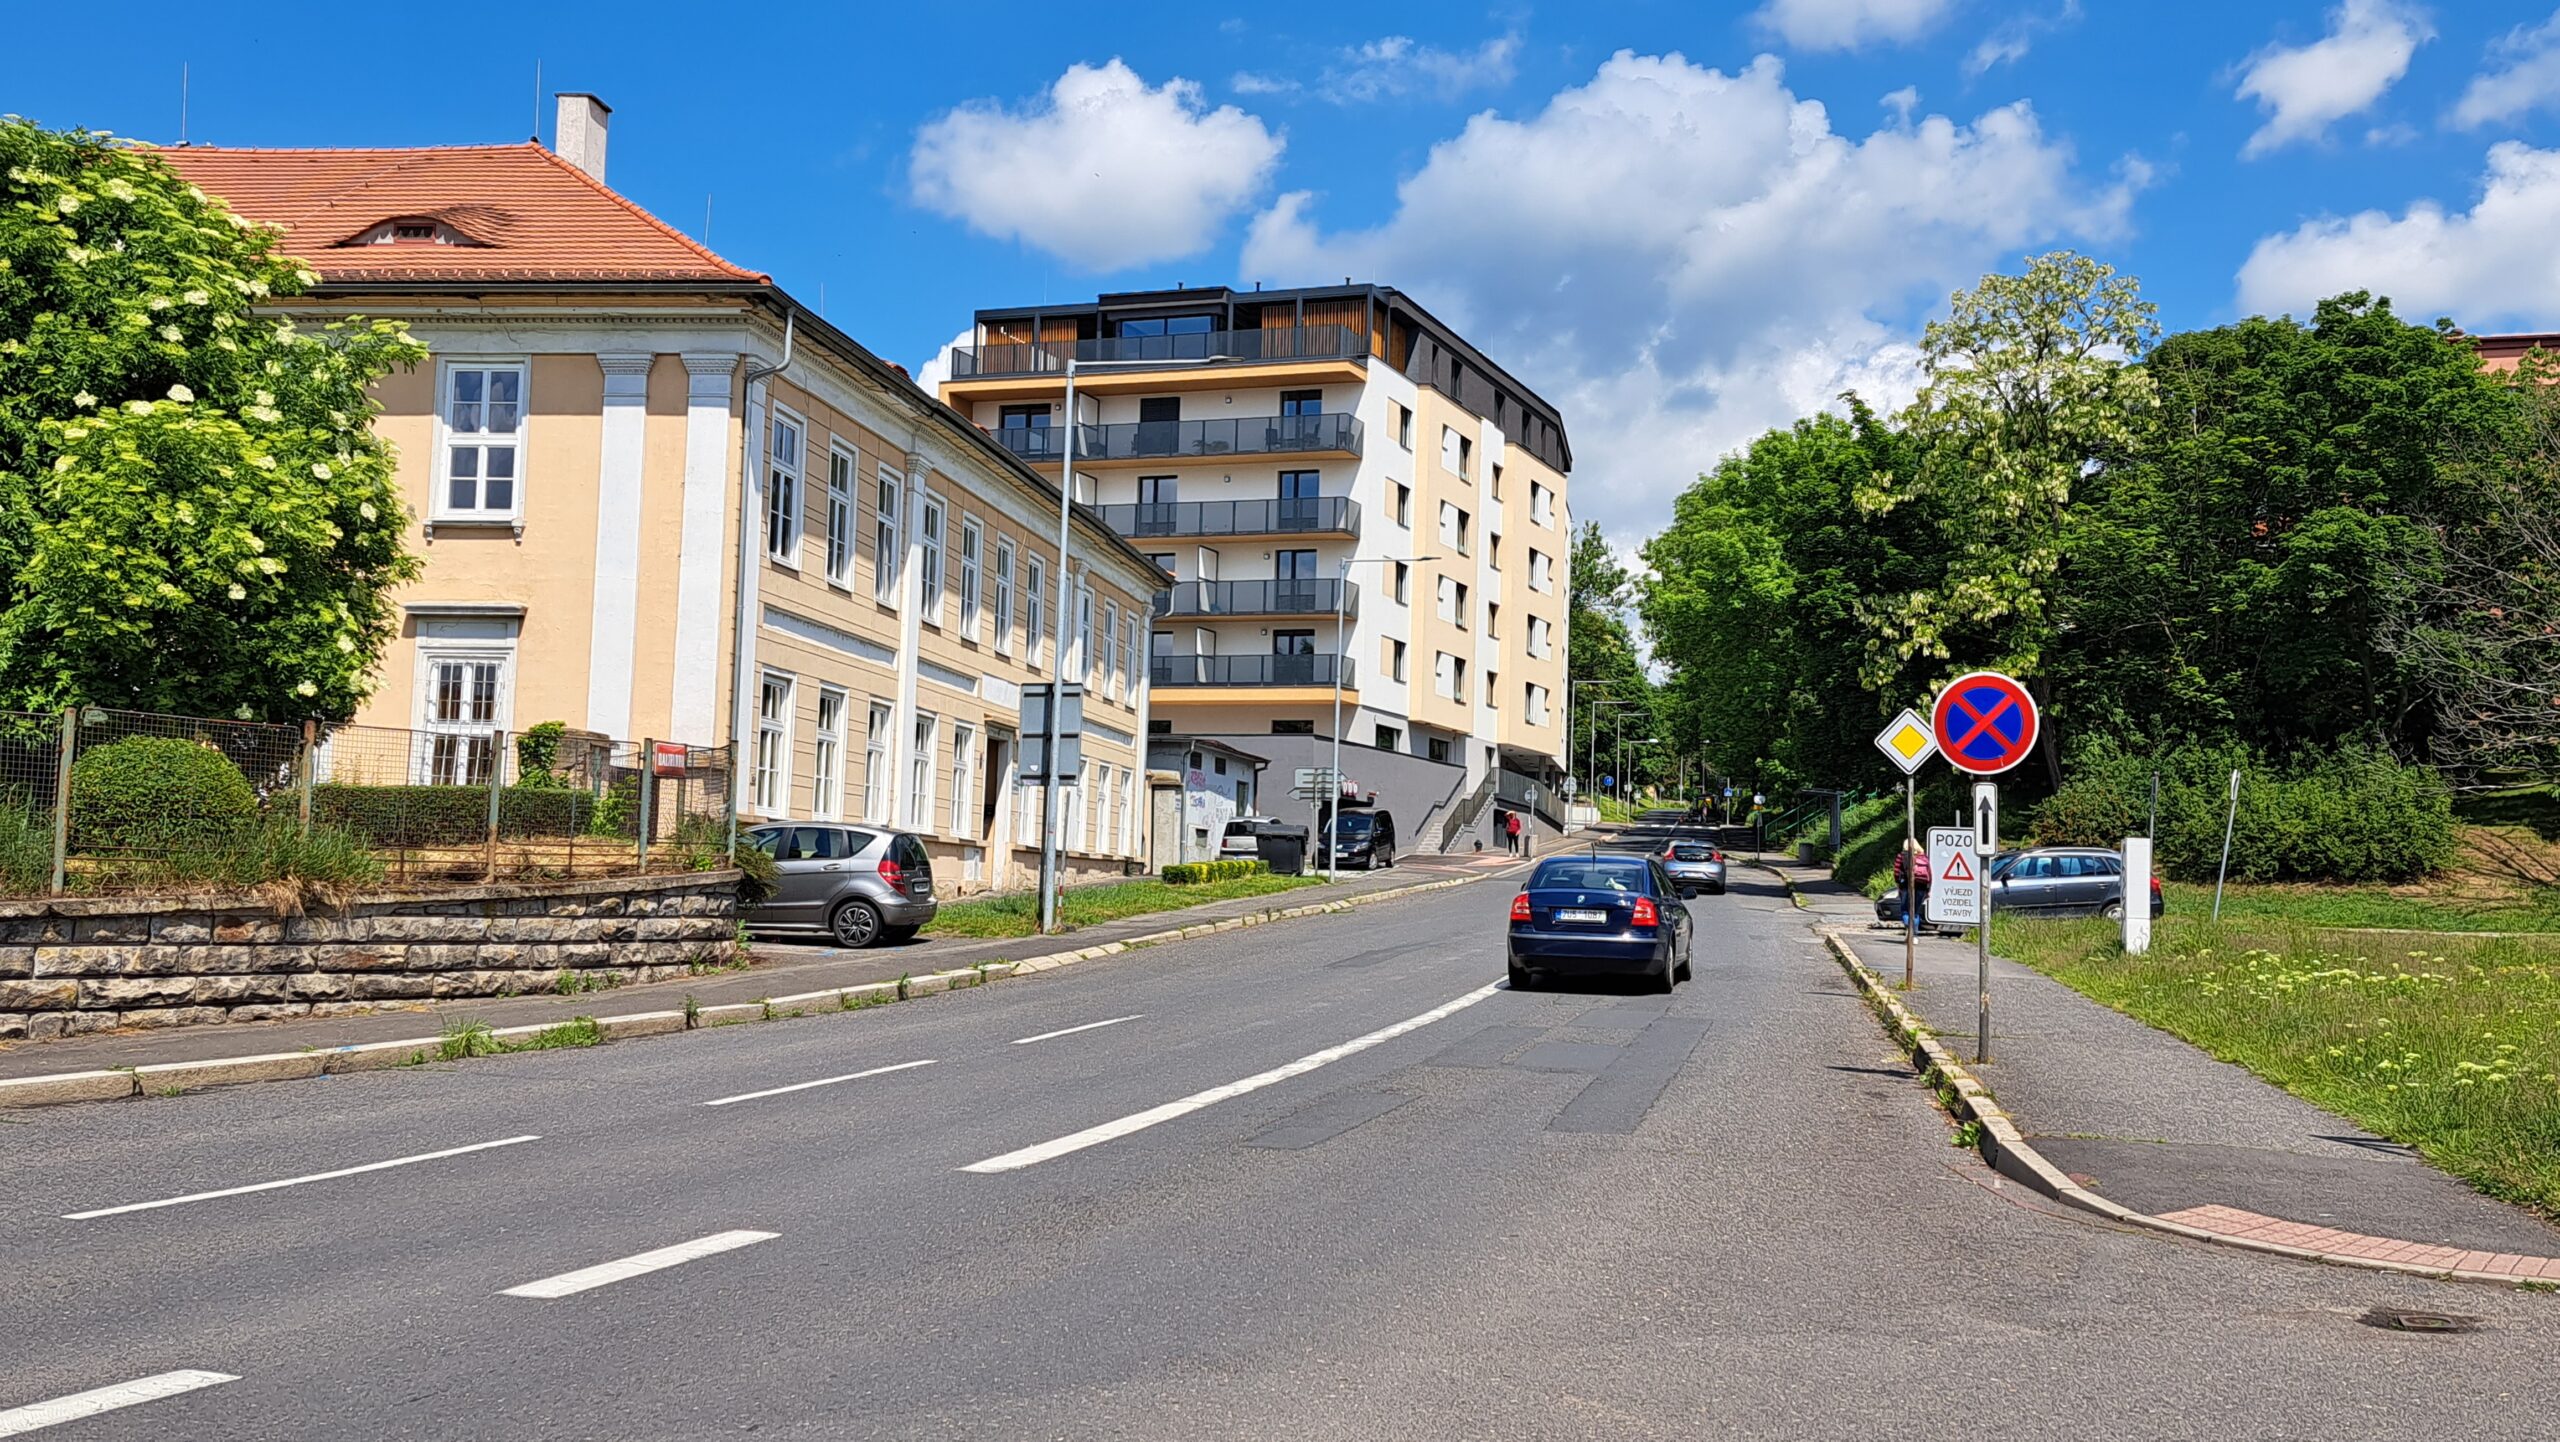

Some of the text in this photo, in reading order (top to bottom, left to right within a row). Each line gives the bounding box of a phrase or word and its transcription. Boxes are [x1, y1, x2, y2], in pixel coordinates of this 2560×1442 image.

[1936, 834, 1973, 848] POZO
[1944, 886, 1973, 896] VÝJEZD
[1942, 898, 1973, 907] VOZIDEL
[1943, 908, 1973, 917] STAVBY
